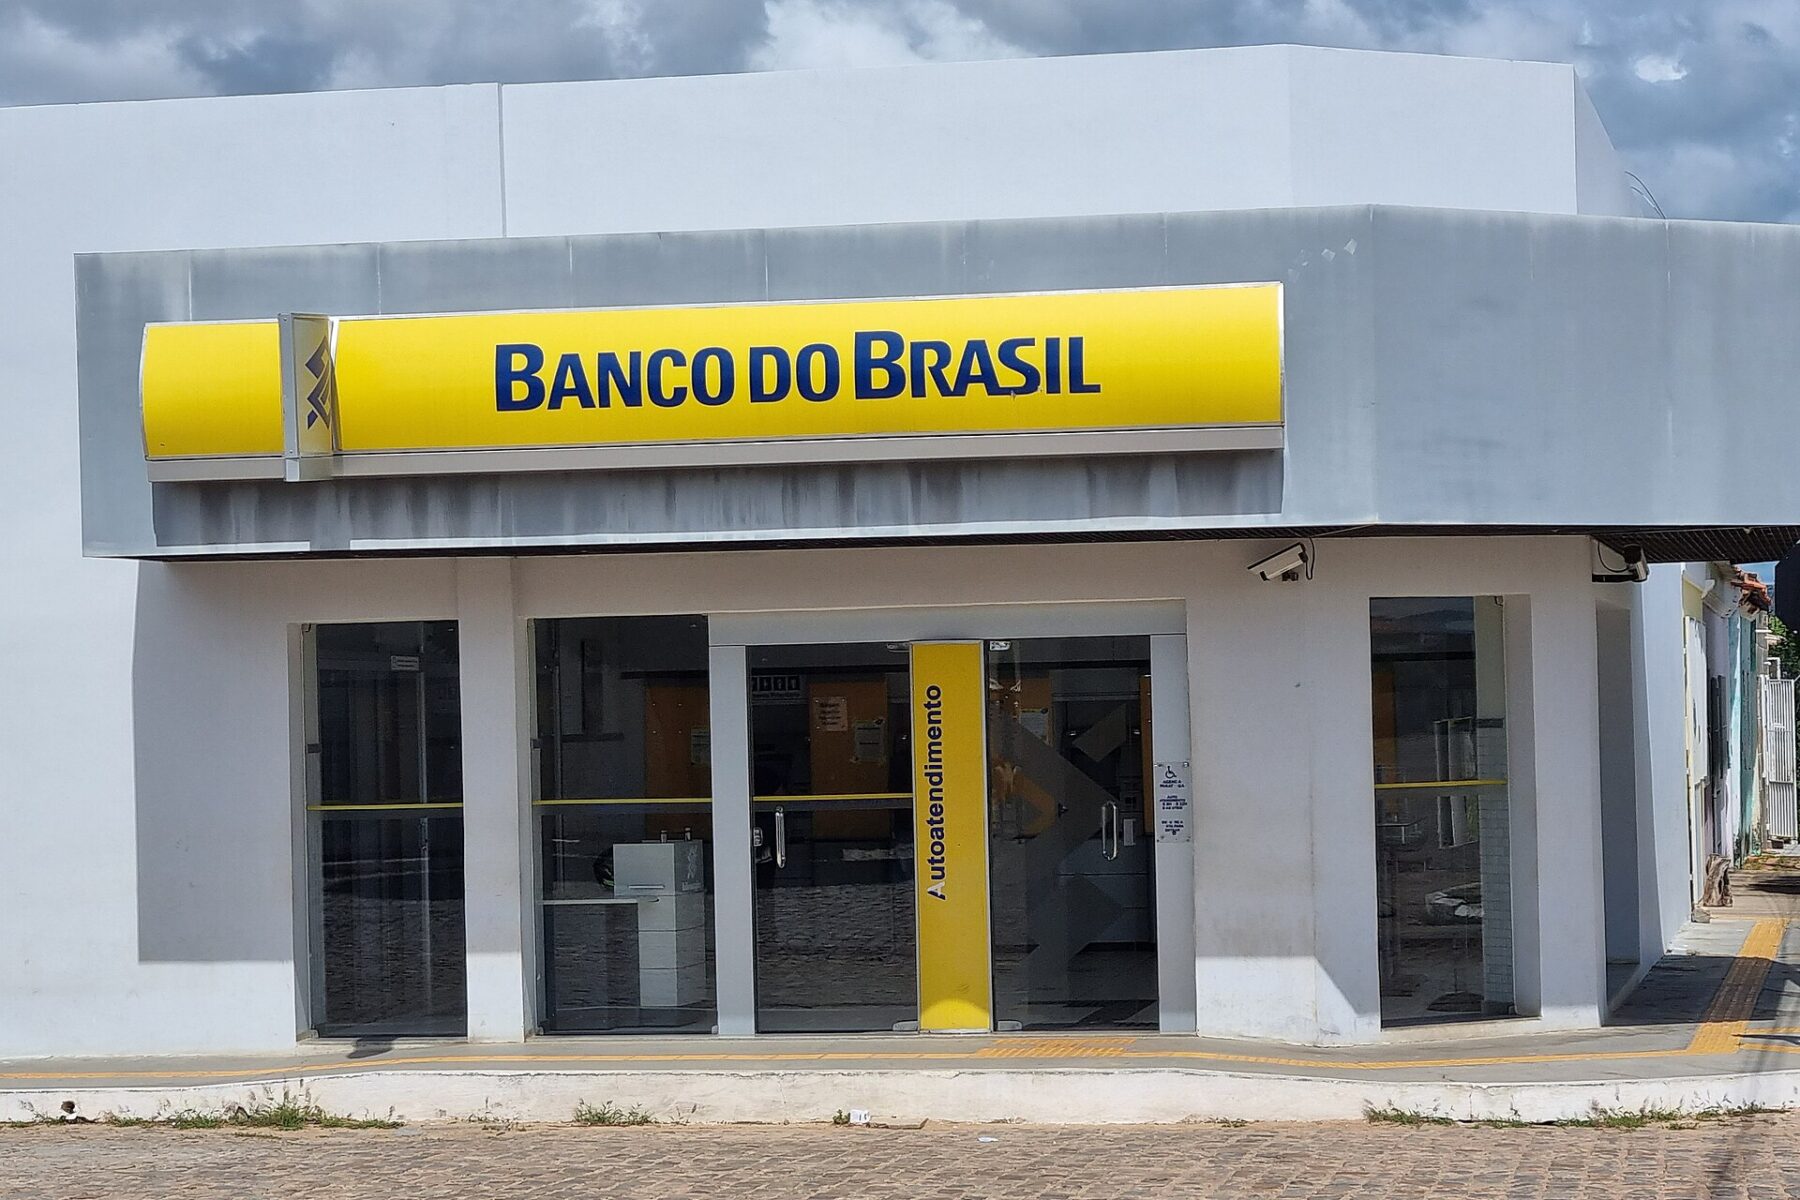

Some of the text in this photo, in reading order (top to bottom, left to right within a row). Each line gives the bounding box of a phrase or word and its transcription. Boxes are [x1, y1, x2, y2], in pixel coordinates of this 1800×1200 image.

[496, 331, 1101, 413] BANCO DO BRASIL
[924, 685, 946, 900] Autoatendimento
